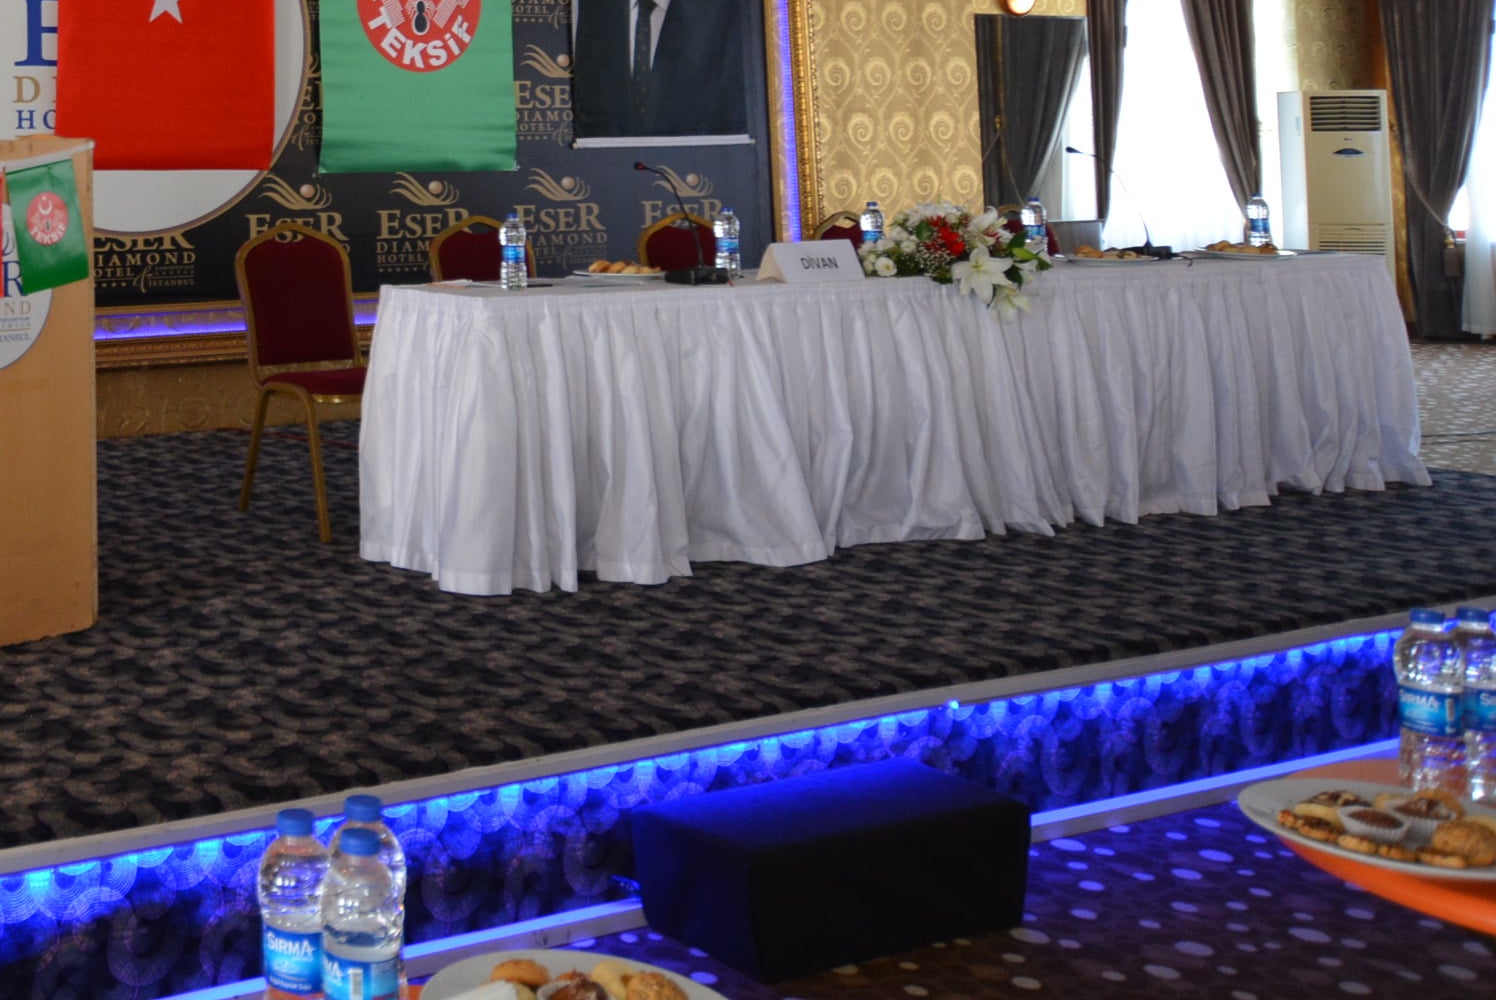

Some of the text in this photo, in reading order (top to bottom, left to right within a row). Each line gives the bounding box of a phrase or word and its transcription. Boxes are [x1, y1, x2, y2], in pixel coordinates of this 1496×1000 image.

[514, 5, 550, 14] OTEL
[514, 80, 572, 108] ESE
[516, 110, 574, 121] IAMO
[519, 122, 554, 131] OTEL
[513, 202, 606, 232] ESER
[376, 240, 430, 253] DIAM
[97, 251, 196, 267] IAMOND
[377, 254, 424, 263] HOTEL
[95, 267, 135, 278] OTEL
